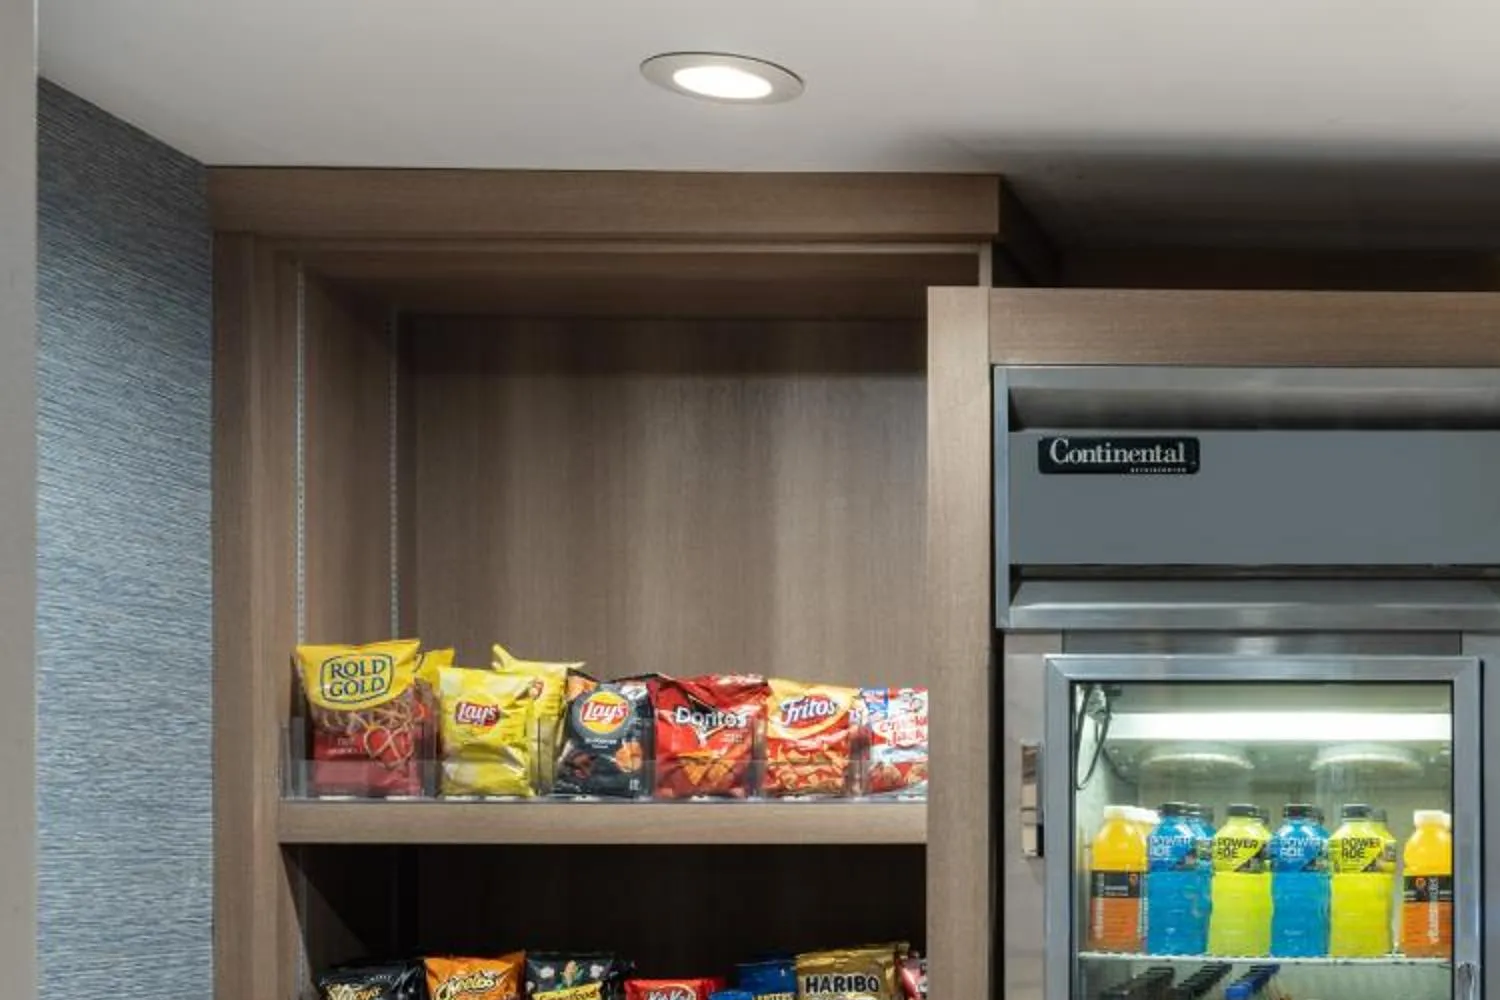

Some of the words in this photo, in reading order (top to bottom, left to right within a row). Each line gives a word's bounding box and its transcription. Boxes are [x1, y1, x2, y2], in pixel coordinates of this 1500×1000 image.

[1050, 438, 1185, 464] Continental
[330, 659, 386, 678] ROLD
[330, 677, 385, 697] GOLD
[457, 702, 498, 724] Lay's
[584, 701, 629, 724] Lay's
[676, 707, 747, 728] Doritos
[781, 694, 837, 725] Fritos
[805, 974, 879, 994] HARIBO
